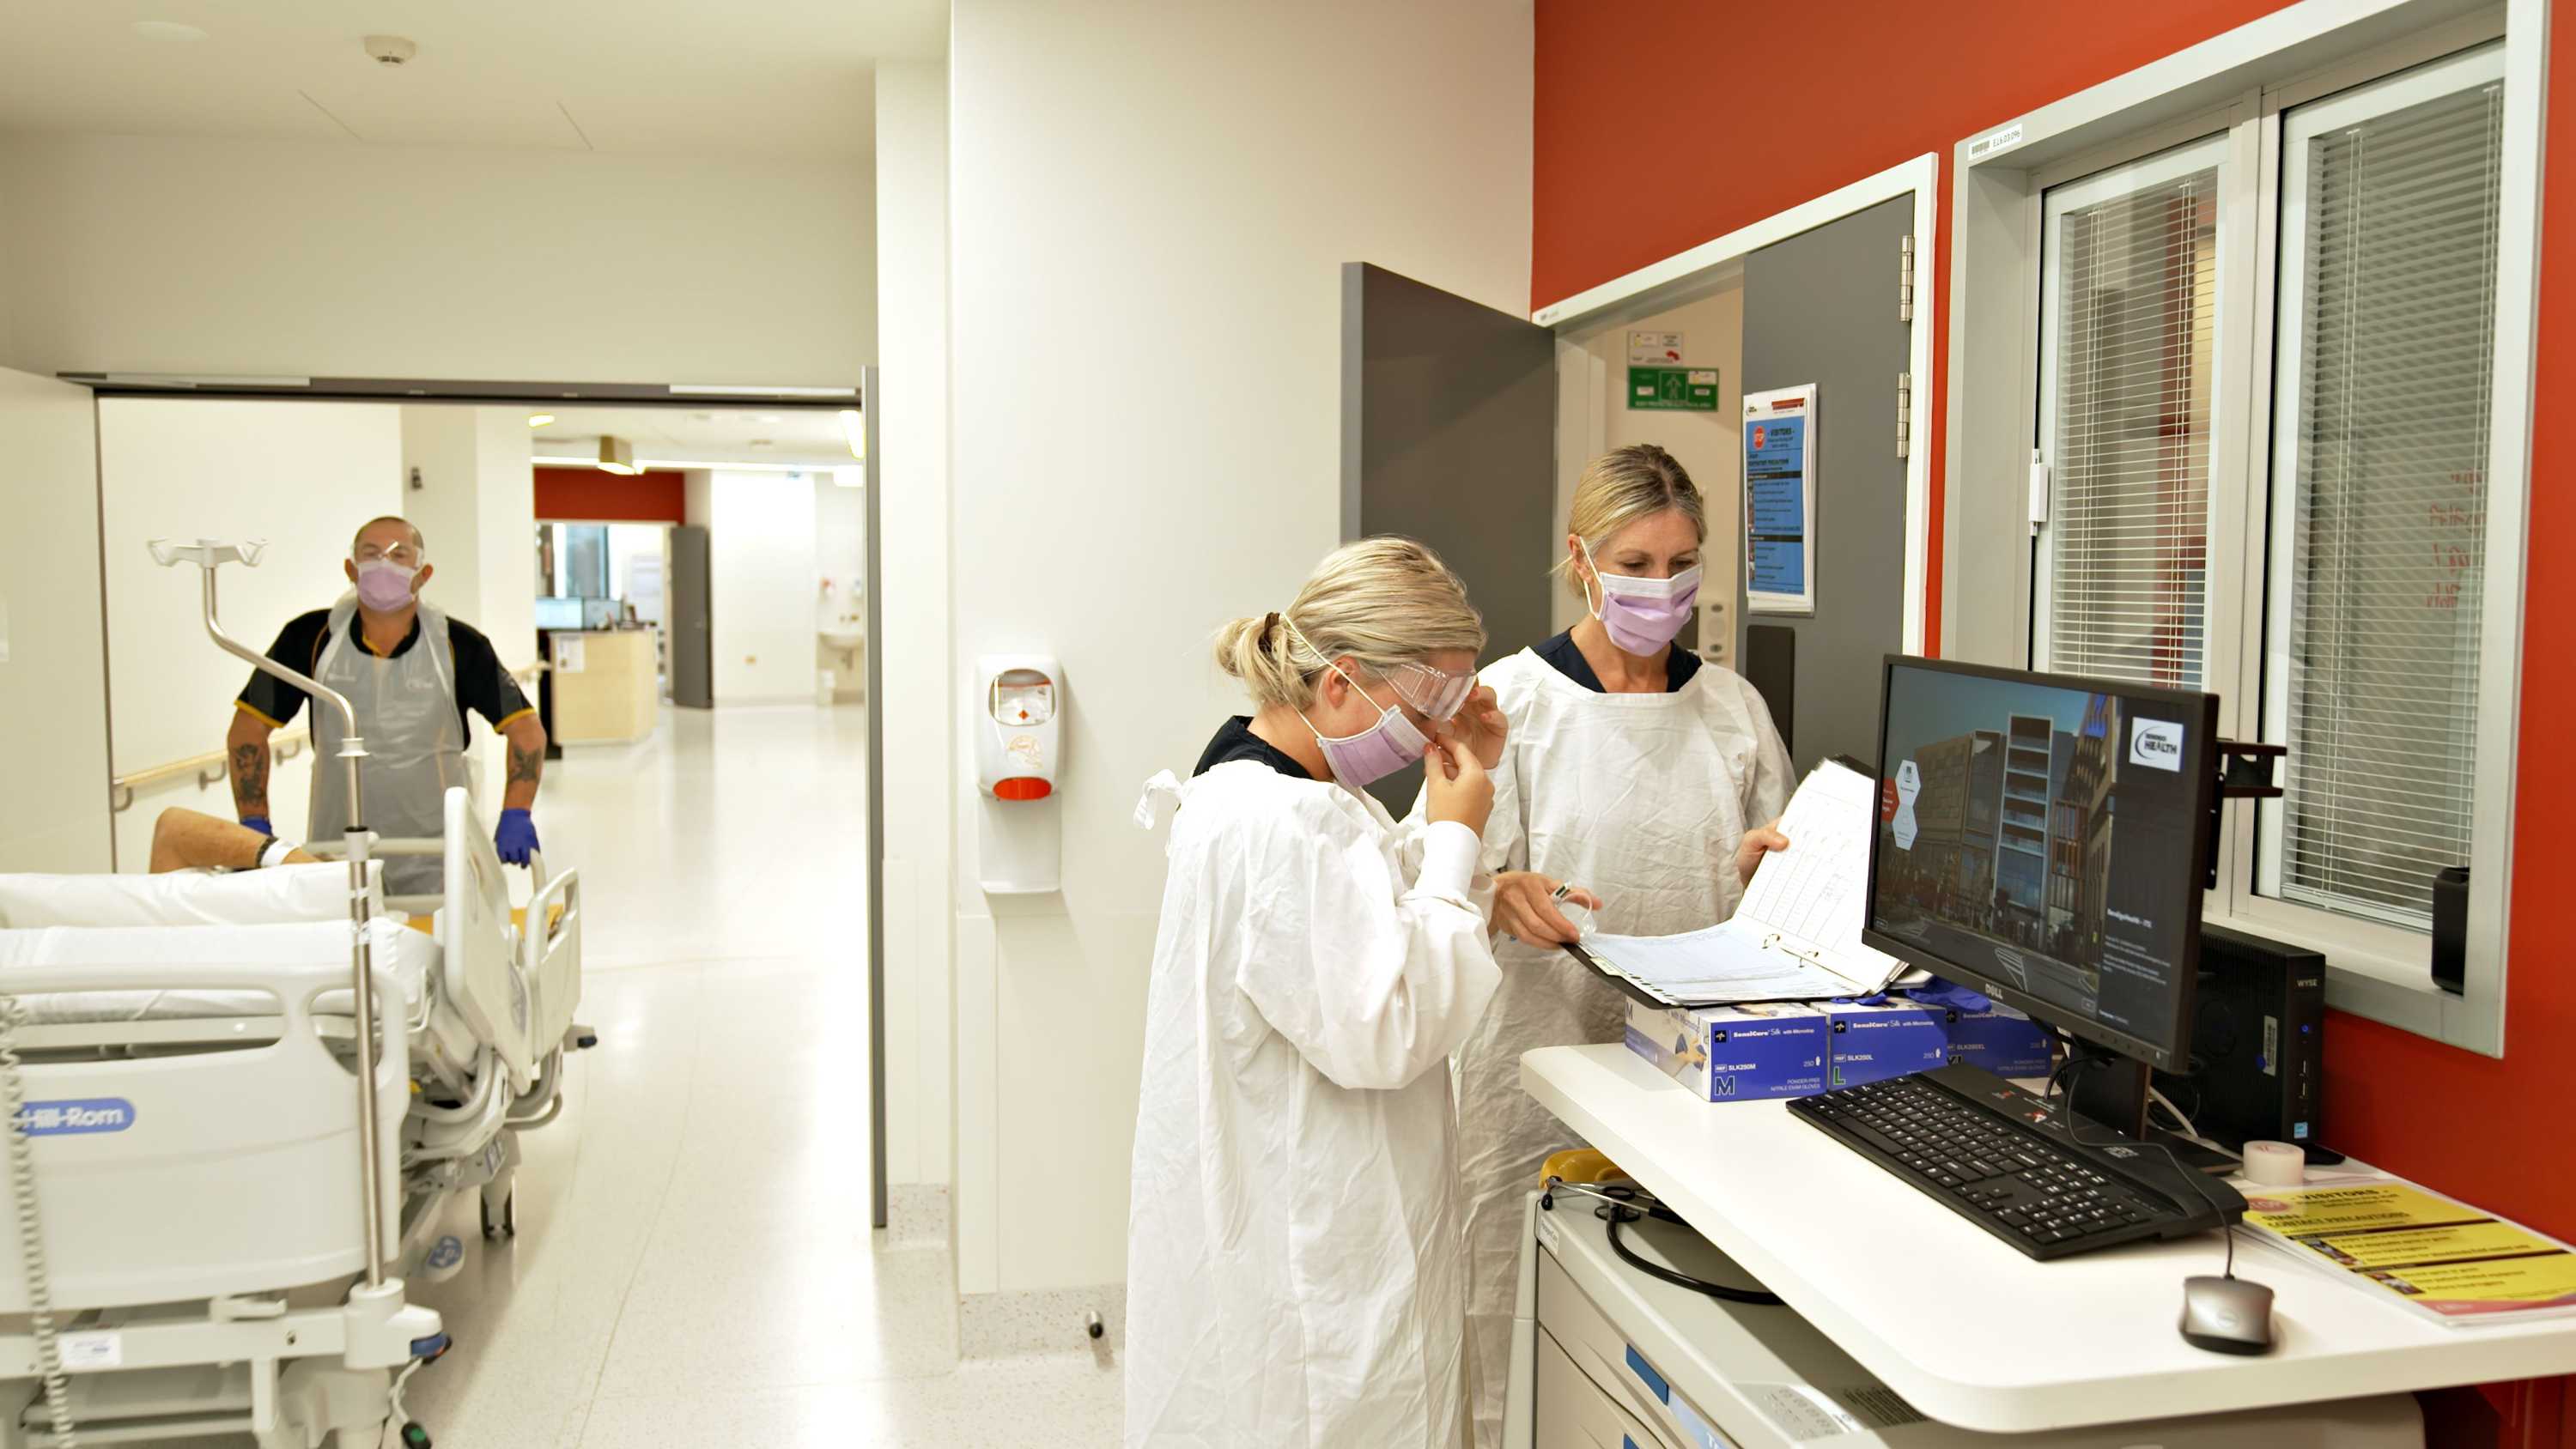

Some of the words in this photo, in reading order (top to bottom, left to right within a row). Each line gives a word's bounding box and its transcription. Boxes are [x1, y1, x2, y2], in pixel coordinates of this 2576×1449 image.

[2144, 740, 2178, 755] HEALTH
[2297, 979, 2318, 987] WYSE
[1985, 983, 2003, 999] DELL
[1833, 1066, 1846, 1085] L
[1715, 1076, 1735, 1096] M
[2297, 1189, 2379, 1199] VISITORS
